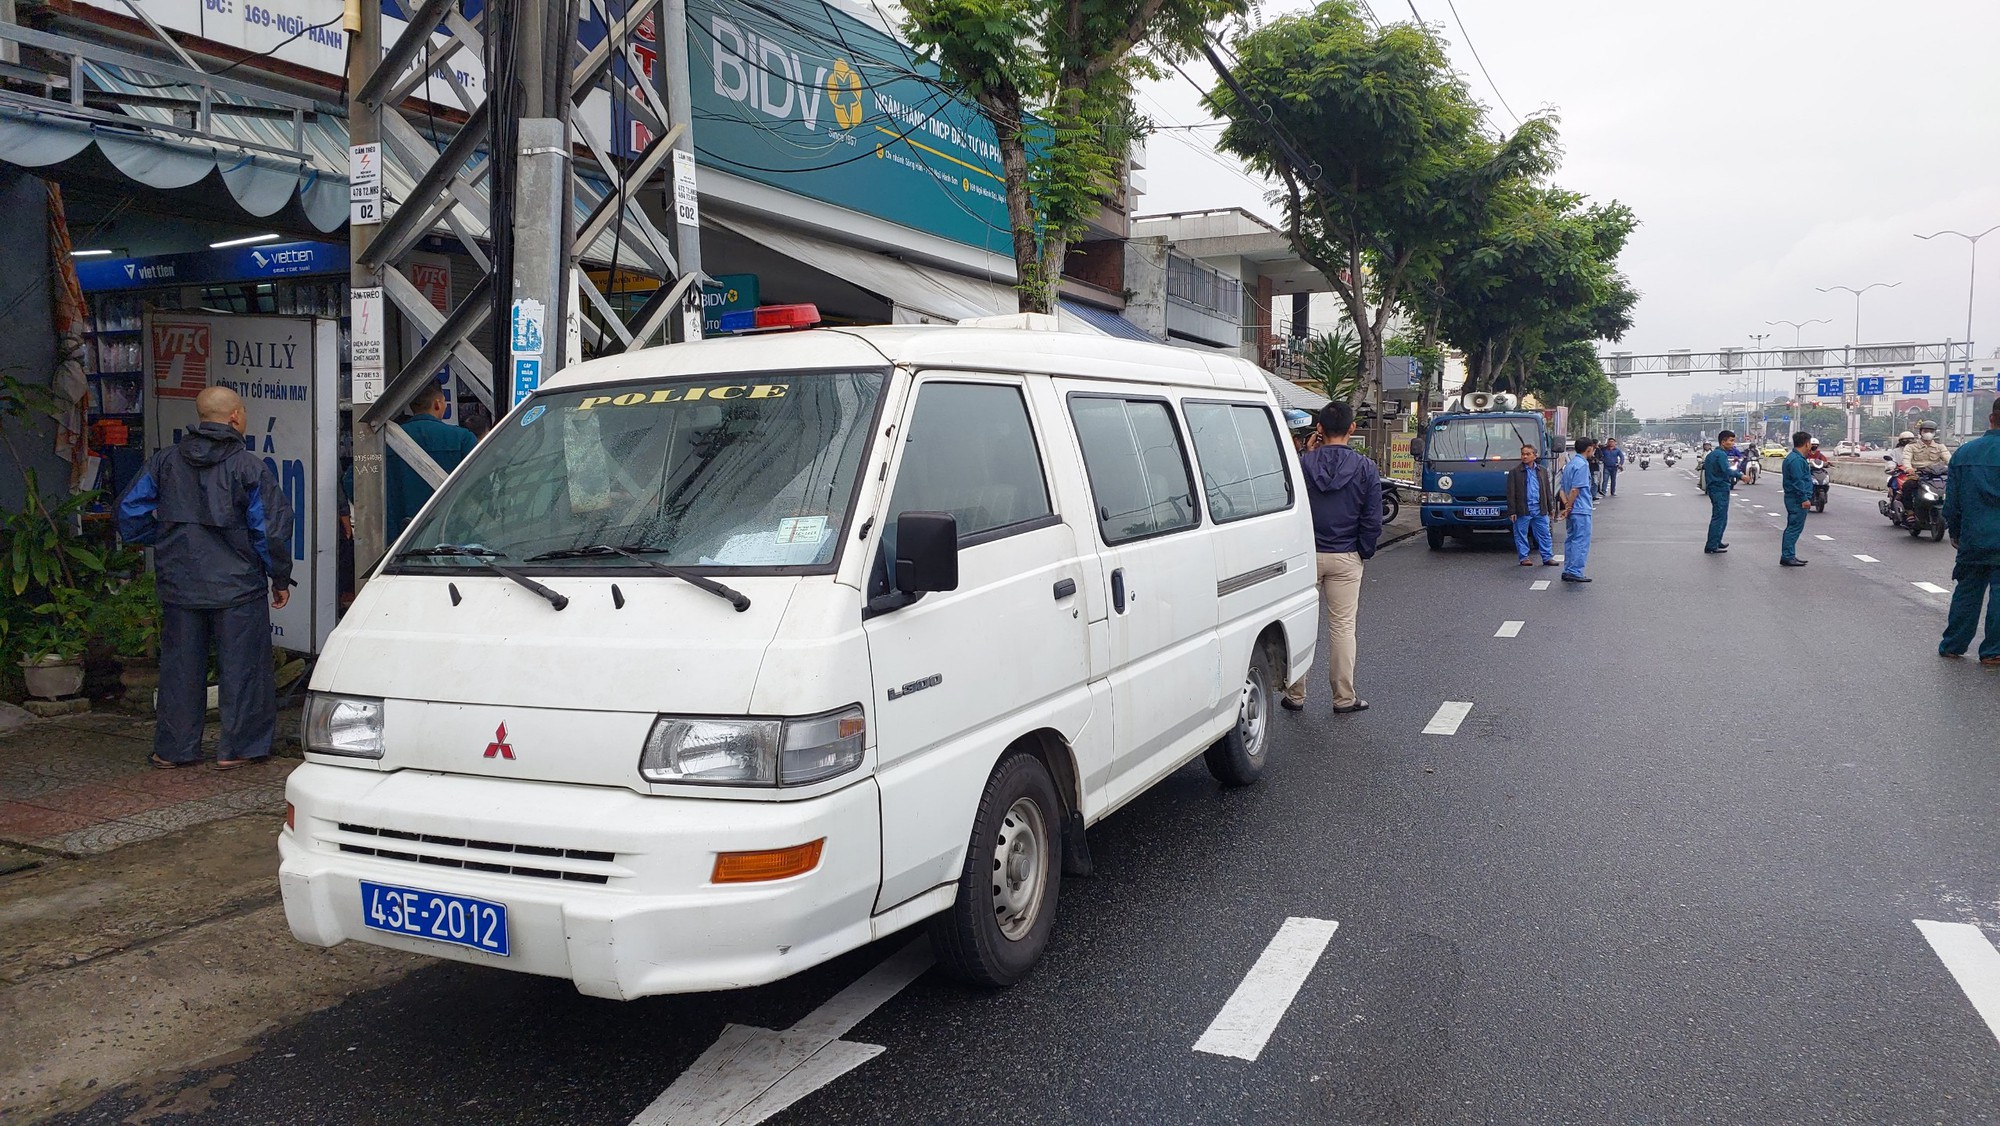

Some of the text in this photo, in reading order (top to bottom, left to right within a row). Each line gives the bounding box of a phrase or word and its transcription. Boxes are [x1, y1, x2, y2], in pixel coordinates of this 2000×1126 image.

[711, 15, 828, 131] BIDV
[874, 90, 900, 120] NGÂN
[902, 103, 926, 131] HÀNG
[928, 116, 950, 140] TMCP
[361, 205, 373, 218] 02
[414, 264, 447, 286] VTEC
[701, 292, 728, 307] BIDV
[154, 328, 208, 357] VTEC
[225, 335, 297, 374] ĐẠI LÝ
[239, 382, 249, 397] TY
[264, 379, 287, 400] PHẦN
[289, 385, 308, 401] MAY
[364, 382, 372, 390] 02
[577, 384, 790, 411] POLICE
[371, 888, 499, 948] 43E-2012
